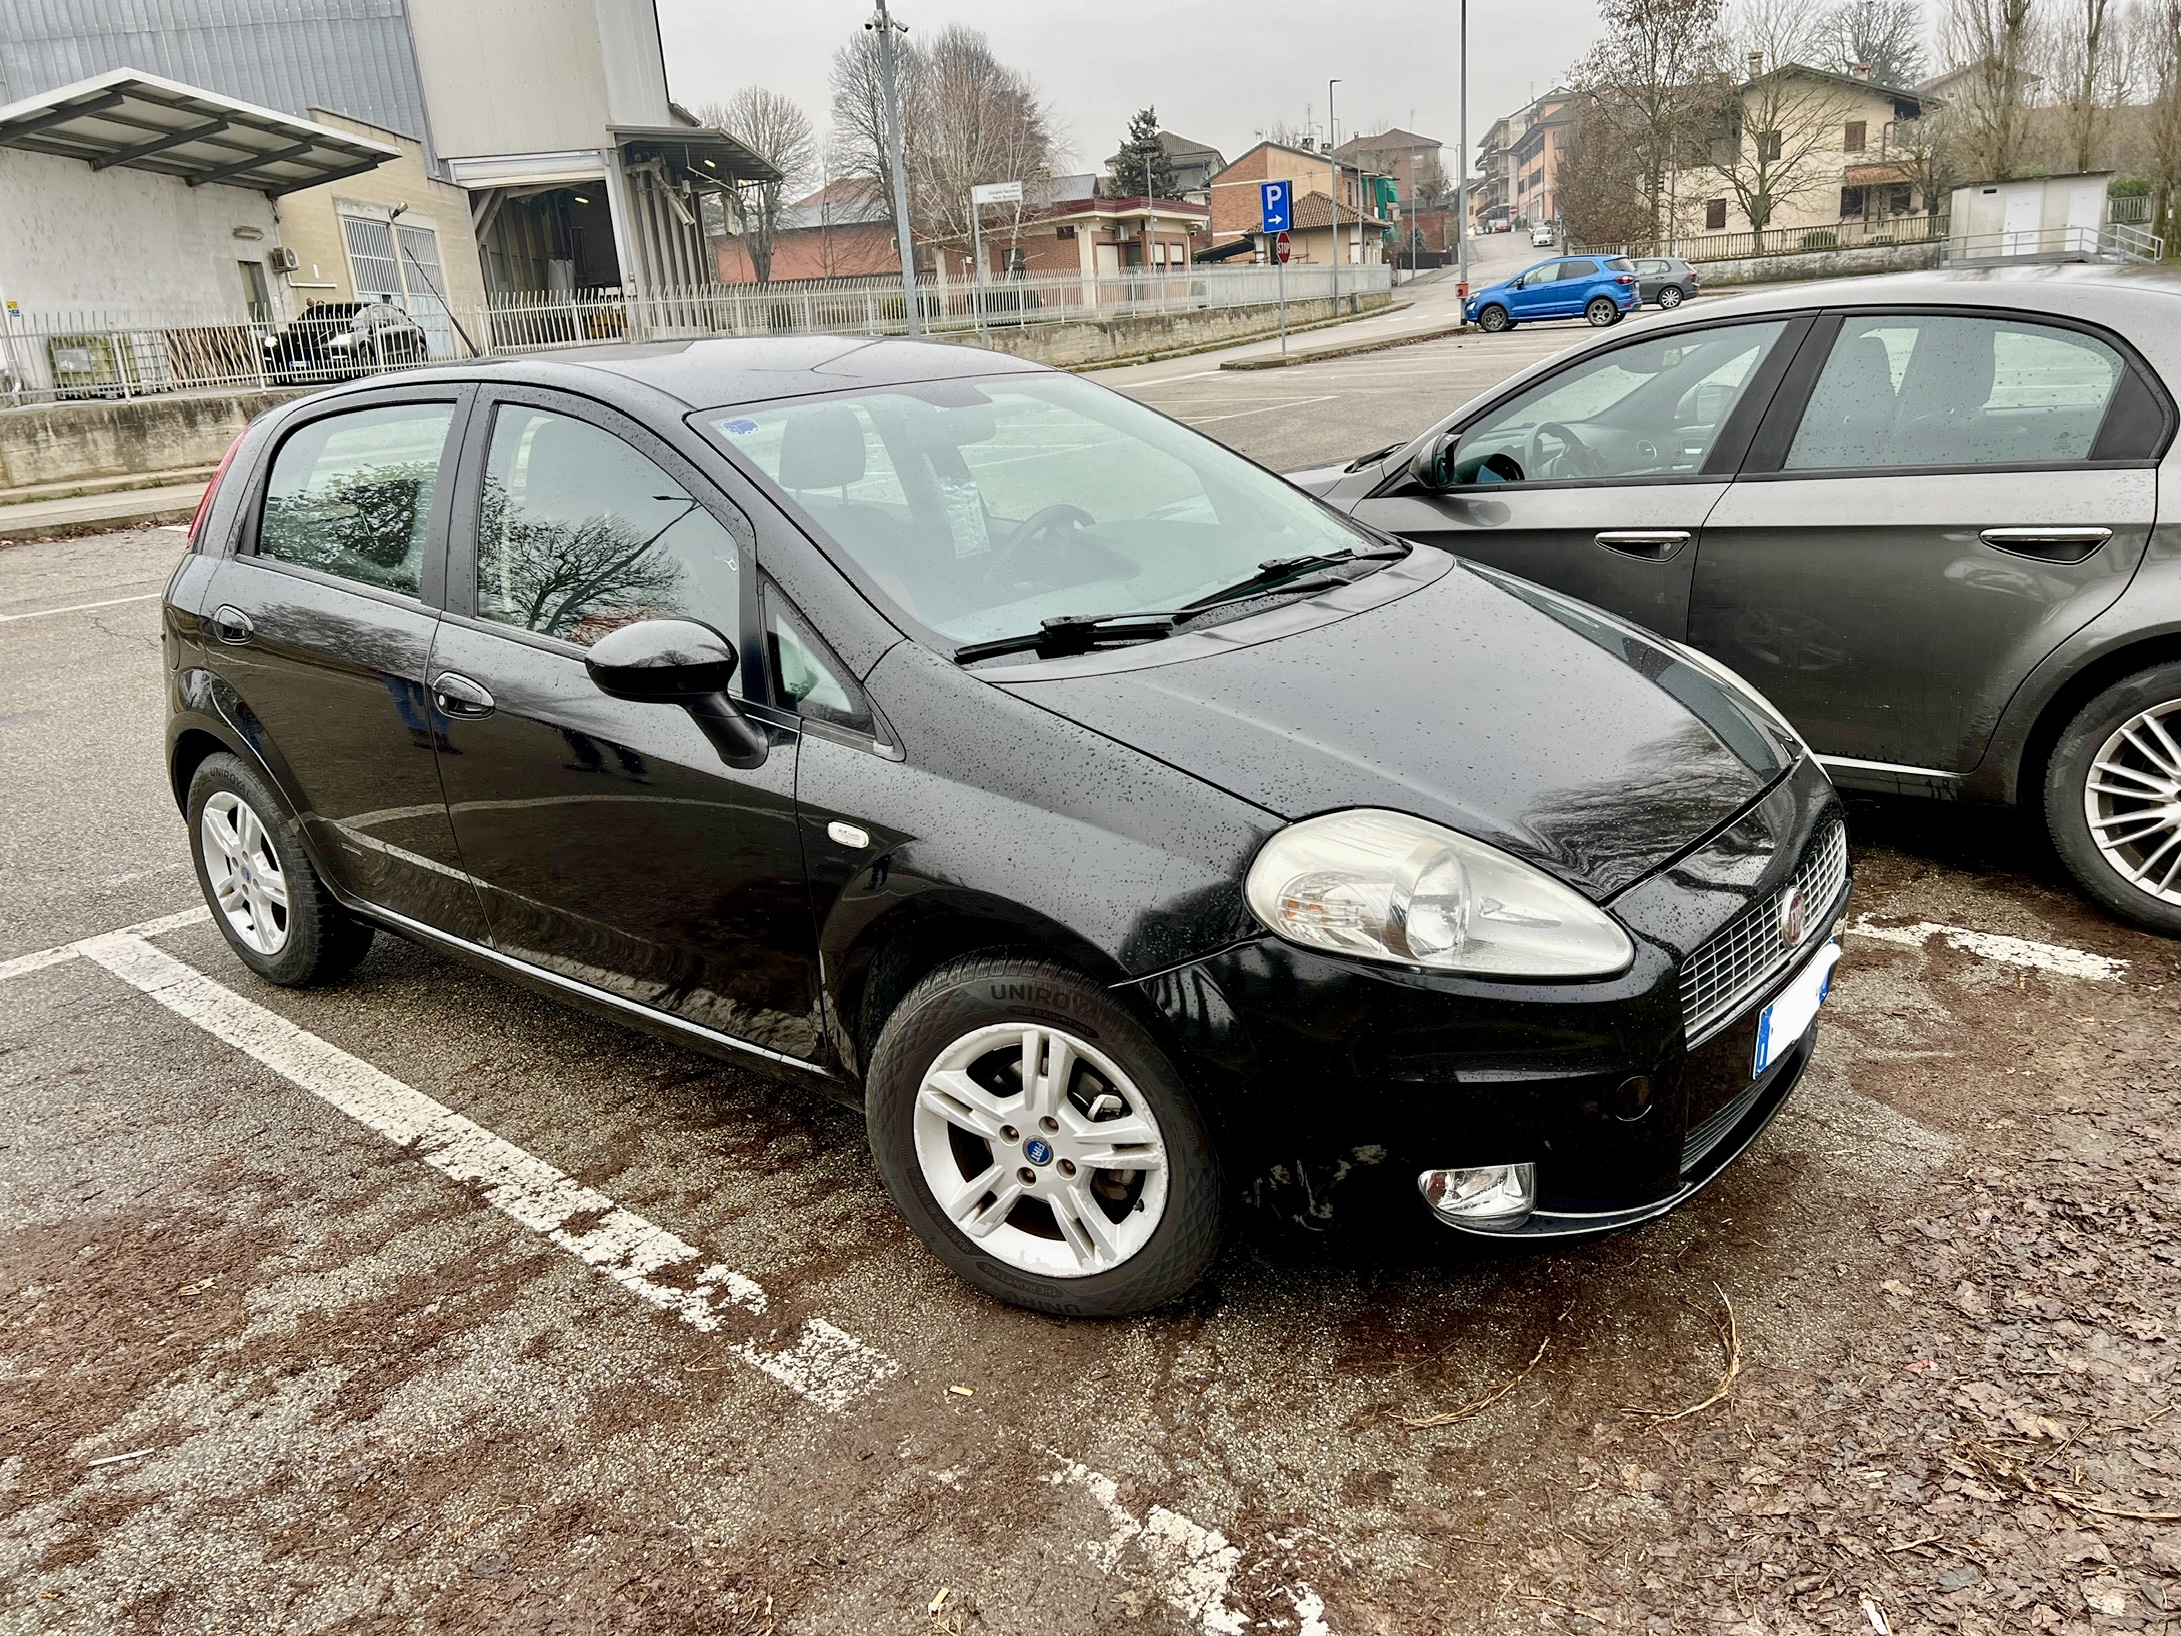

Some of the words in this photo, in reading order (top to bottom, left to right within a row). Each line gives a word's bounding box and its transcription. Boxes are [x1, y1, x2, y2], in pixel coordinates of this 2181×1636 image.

[1266, 185, 1282, 210] P
[1277, 242, 1290, 255] STOP
[1035, 1010, 1059, 1021] RAIN
[1030, 1141, 1046, 1162] FIAT
[1012, 1279, 1036, 1291] RAIN
[1039, 1286, 1057, 1295] THE
